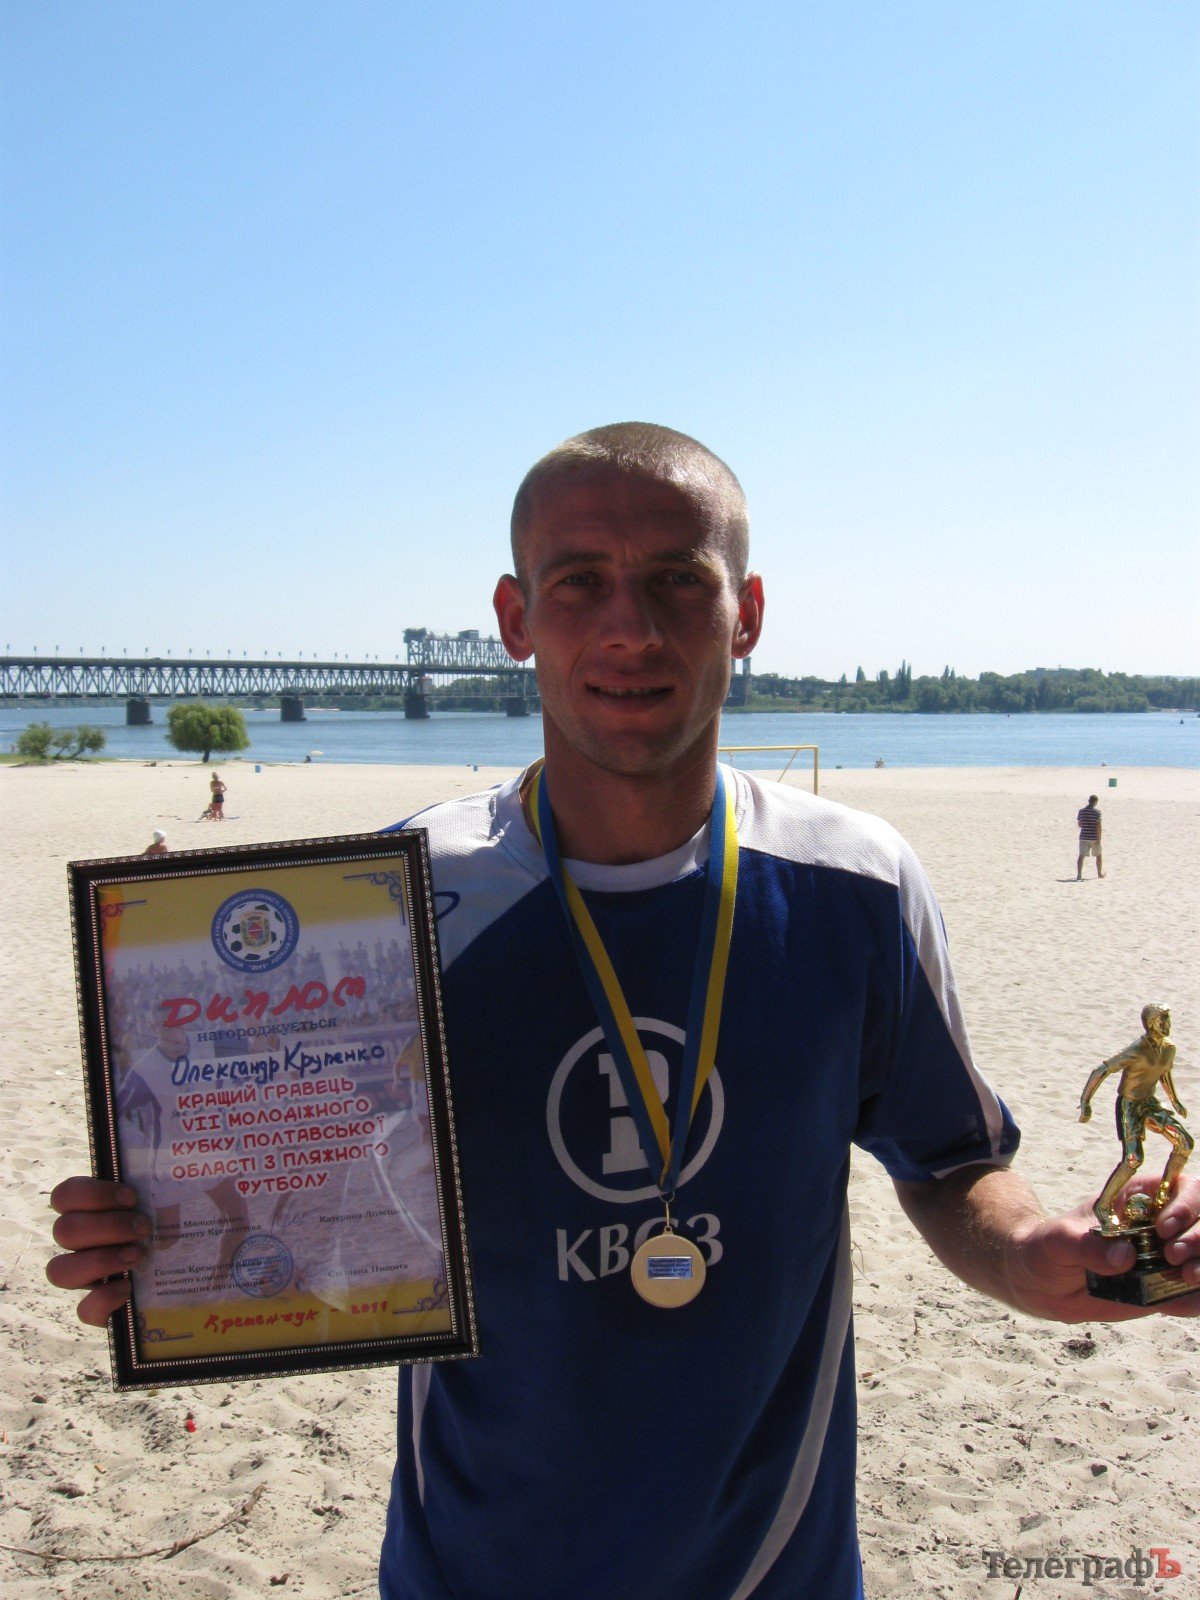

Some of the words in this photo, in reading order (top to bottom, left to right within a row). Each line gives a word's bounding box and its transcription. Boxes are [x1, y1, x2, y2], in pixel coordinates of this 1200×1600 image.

[197, 1016, 338, 1042] нагороджується
[171, 1054, 280, 1086] Олександр
[284, 1041, 386, 1078] Крупенко
[178, 1084, 257, 1110] КРАЩИЙ
[264, 1077, 354, 1100] ГРАВЕЦЬ
[228, 1098, 370, 1128] МОЛОДІЖНОГО
[172, 1137, 235, 1157] КУБКУ
[243, 1115, 386, 1149] ПОЛТАВСЬКОЇ
[172, 1157, 256, 1180] ОБЛАСТІ
[283, 1142, 389, 1167] ПЛЯЖНОГО
[237, 1172, 329, 1195] ФУТБОЛУ
[351, 1300, 388, 1315] 2011
